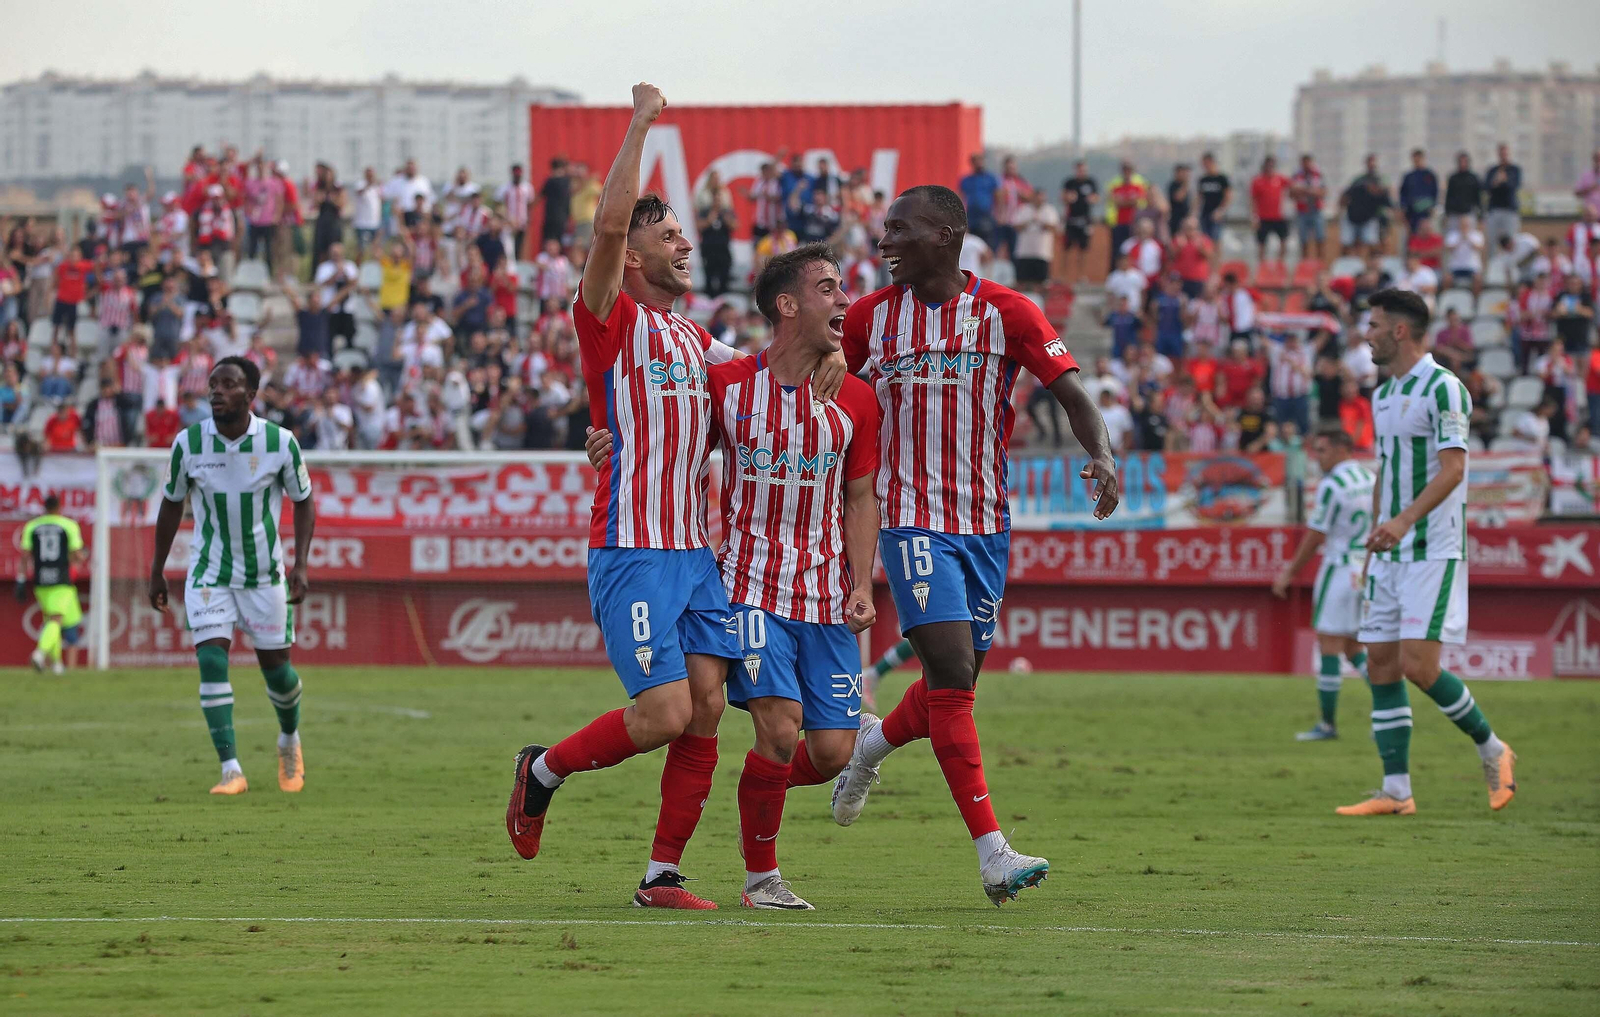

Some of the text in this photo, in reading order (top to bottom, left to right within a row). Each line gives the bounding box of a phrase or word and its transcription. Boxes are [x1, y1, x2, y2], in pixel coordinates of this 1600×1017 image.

[880, 351, 984, 378] SCAMP
[738, 445, 837, 475] SCAMP
[899, 536, 934, 581] 15
[631, 602, 651, 642] 8
[735, 609, 766, 650] 10
[831, 673, 862, 698] EX
